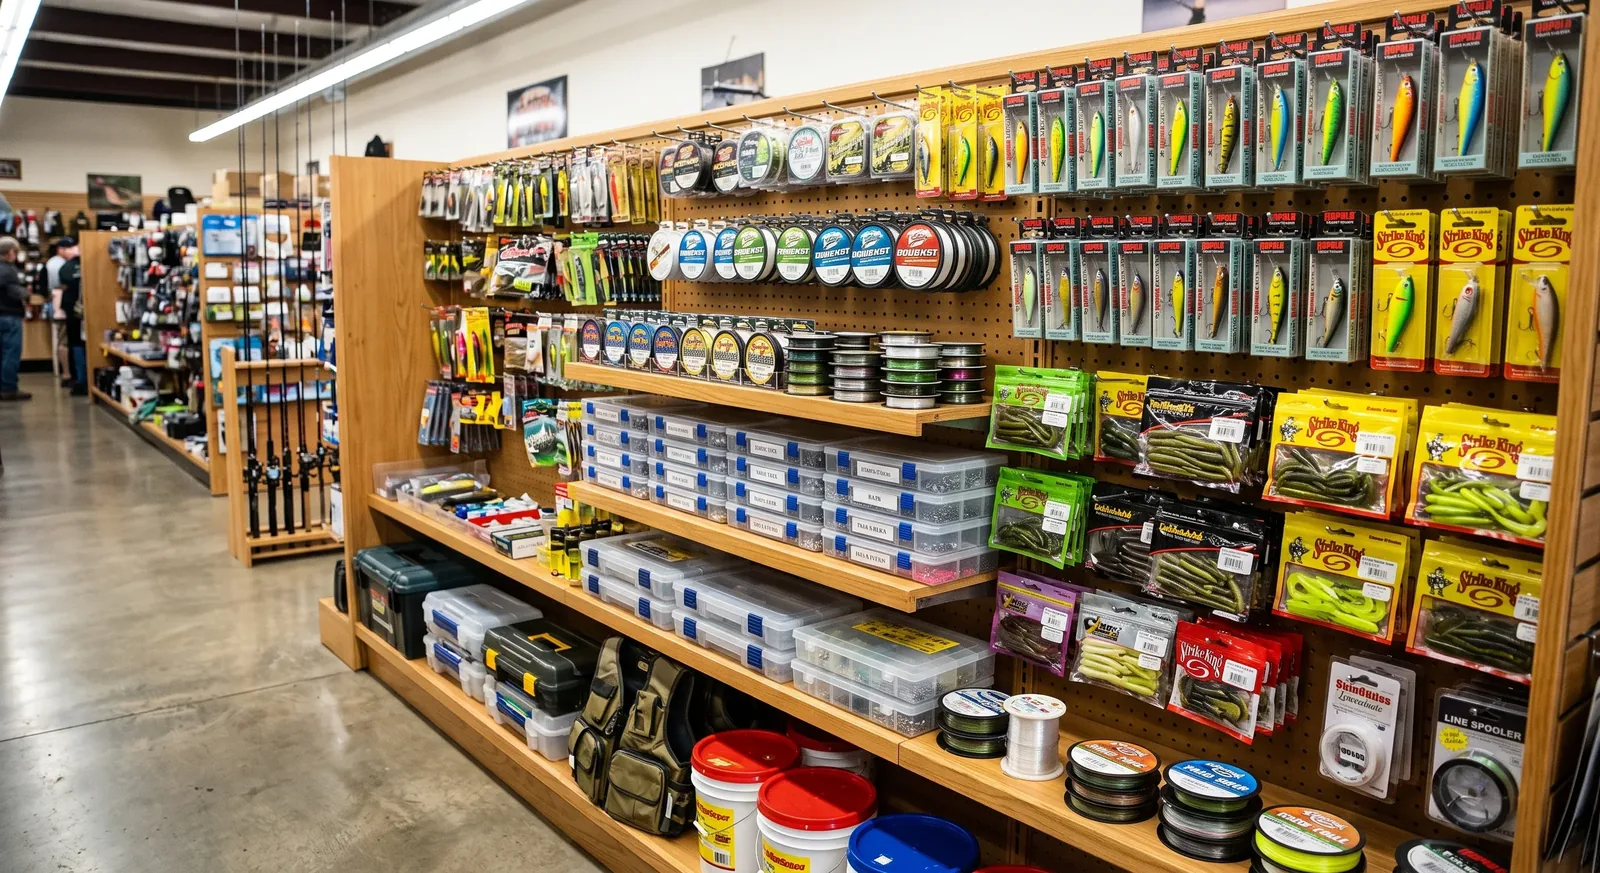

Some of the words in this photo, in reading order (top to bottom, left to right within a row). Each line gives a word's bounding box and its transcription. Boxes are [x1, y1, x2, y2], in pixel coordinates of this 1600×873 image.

[1384, 43, 1414, 55] RAPALA
[1324, 211, 1355, 221] RAPALA
[1317, 241, 1344, 250] RAPALA
[1377, 230, 1404, 251] Strike
[1405, 229, 1425, 250] King
[1443, 229, 1471, 250] Strike
[1471, 228, 1494, 249] King
[1518, 227, 1551, 249] Strike
[1306, 416, 1337, 438] Strike
[1337, 418, 1360, 443] King
[1458, 433, 1496, 457] Strike
[1496, 437, 1523, 464] King
[1312, 538, 1343, 560] Strike
[1343, 543, 1366, 568] King
[1457, 570, 1493, 593] Strike
[1493, 576, 1521, 607] King
[1180, 641, 1205, 662] Strike
[1204, 649, 1224, 678] King
[1444, 714, 1468, 727] LINE
[1471, 720, 1522, 741] SPOOLER
